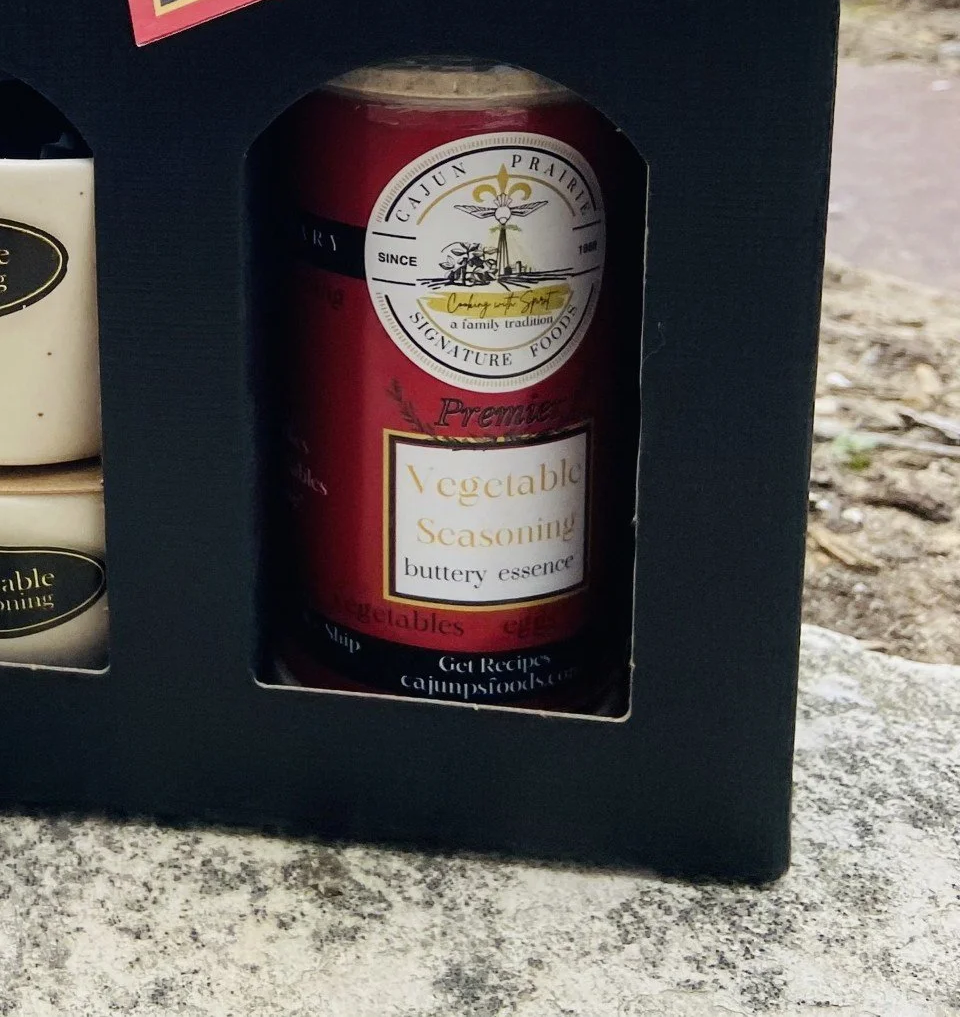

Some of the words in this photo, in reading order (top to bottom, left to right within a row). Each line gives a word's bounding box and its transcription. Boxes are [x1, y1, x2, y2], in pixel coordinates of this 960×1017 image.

[395, 162, 467, 224] CAJUN
[511, 154, 591, 217] PRAIRIE
[377, 251, 418, 268] SINCE
[446, 293, 492, 318] Cooking
[492, 295, 517, 312] with
[449, 321, 458, 329] a
[461, 318, 500, 331] family
[504, 315, 554, 329] tradition
[409, 311, 513, 368] SIGNATURE
[529, 303, 579, 359] FOODS
[406, 458, 583, 507] Vegetable
[416, 512, 575, 549] Seasoning
[404, 557, 487, 589] buttery
[498, 554, 574, 582] essence
[438, 655, 474, 674] Get
[481, 653, 552, 675] Recipes
